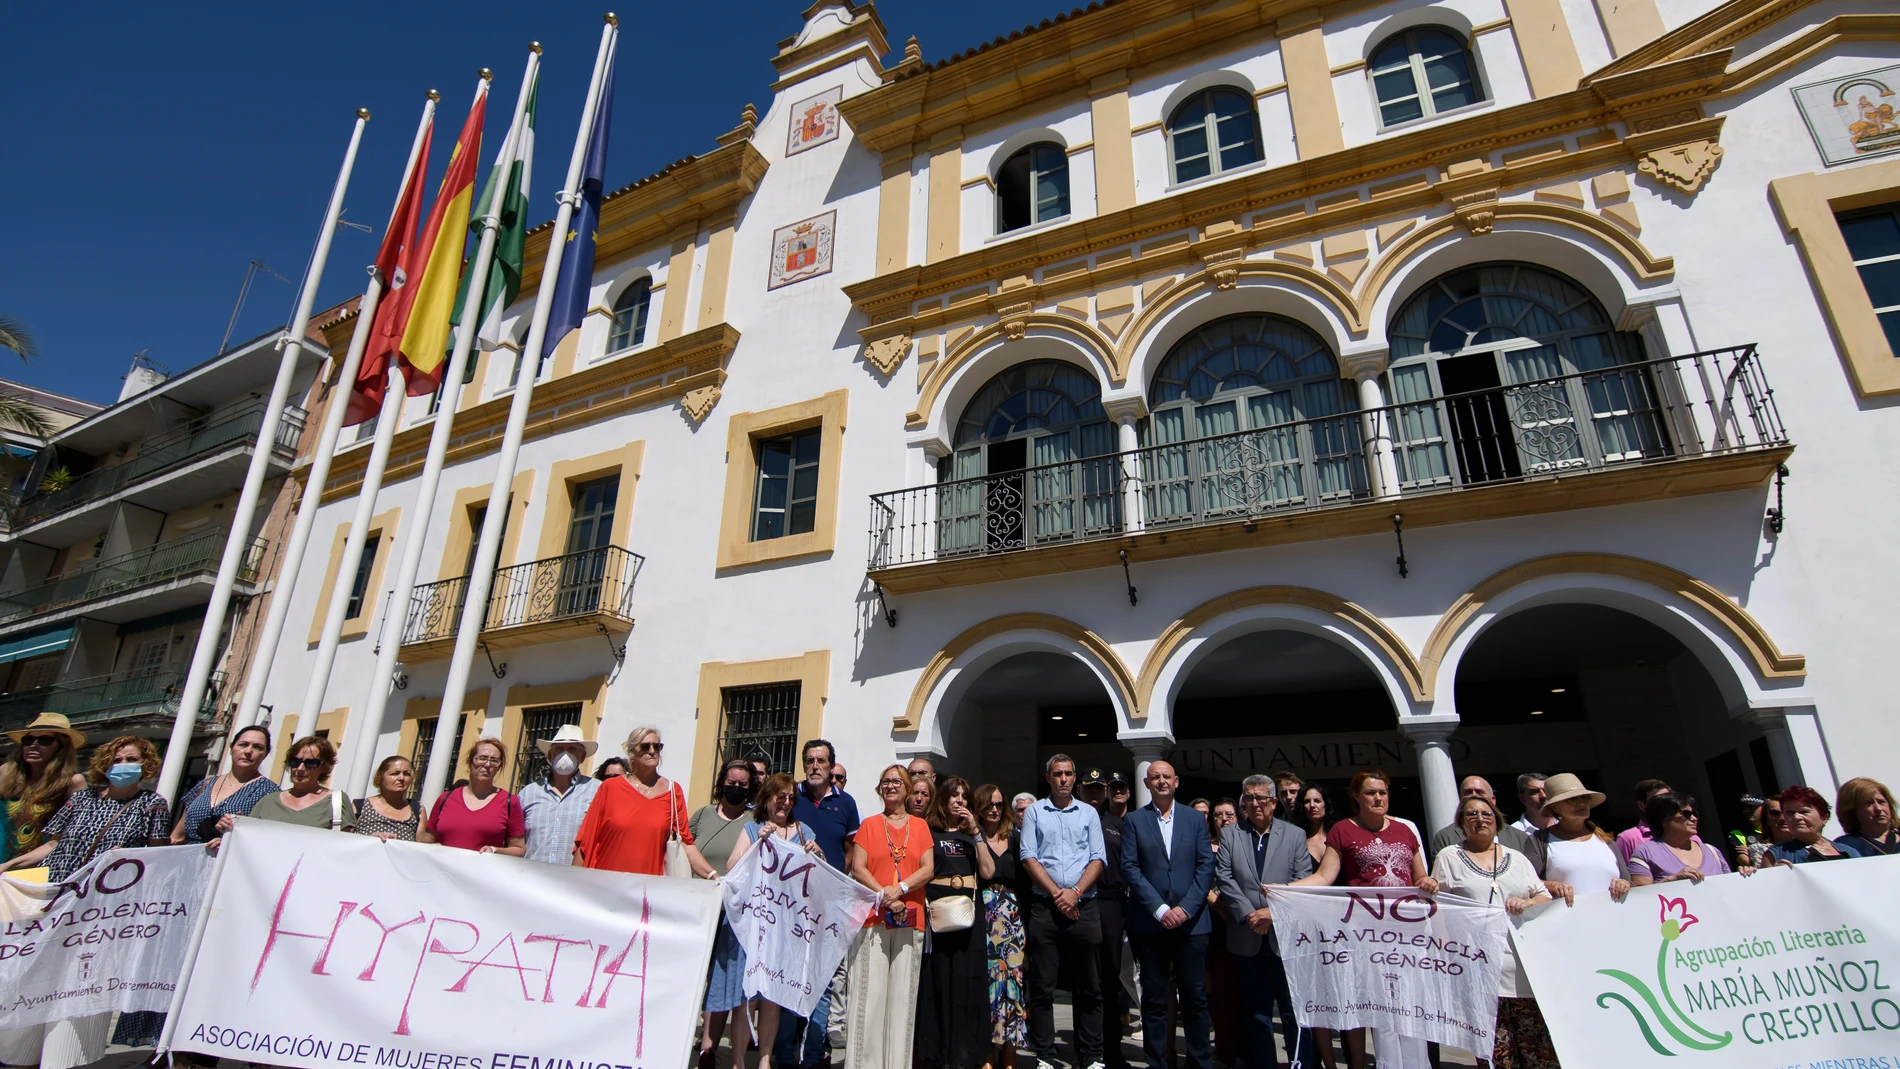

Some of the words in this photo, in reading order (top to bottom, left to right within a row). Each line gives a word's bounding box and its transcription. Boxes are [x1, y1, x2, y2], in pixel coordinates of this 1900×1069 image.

[1166, 739, 1470, 772] UNTAMIENO
[40, 857, 146, 912] NO
[4, 919, 44, 936] LA
[51, 901, 188, 929] VIOLENCIA
[1340, 891, 1437, 923] NO
[0, 942, 36, 960] DE
[63, 924, 162, 948] GÉNERO
[247, 851, 652, 1060] HYPATIA
[1296, 932, 1311, 947] A
[1319, 929, 1348, 944] LA
[1352, 928, 1489, 964] VIOLENCIA
[1674, 936, 1777, 973] Agrupación
[1780, 924, 1867, 952] Literaria
[1320, 951, 1350, 965] DE
[1369, 947, 1463, 976] GÉNERO
[12, 985, 103, 1011] Ayuntamiento
[127, 981, 176, 992] ermanas
[1682, 966, 1770, 1013] MARÍA
[1772, 957, 1891, 998] MUÑOZ
[1305, 1000, 1341, 1013] Excmo.
[1344, 999, 1411, 1017] Ayuntamiento
[1413, 1005, 1434, 1022] Dos
[1742, 998, 1900, 1045] CRESPILLO
[190, 1023, 333, 1059] ASOCIACIÓN
[337, 1042, 371, 1063] DE
[375, 1047, 483, 1069] MUJERES
